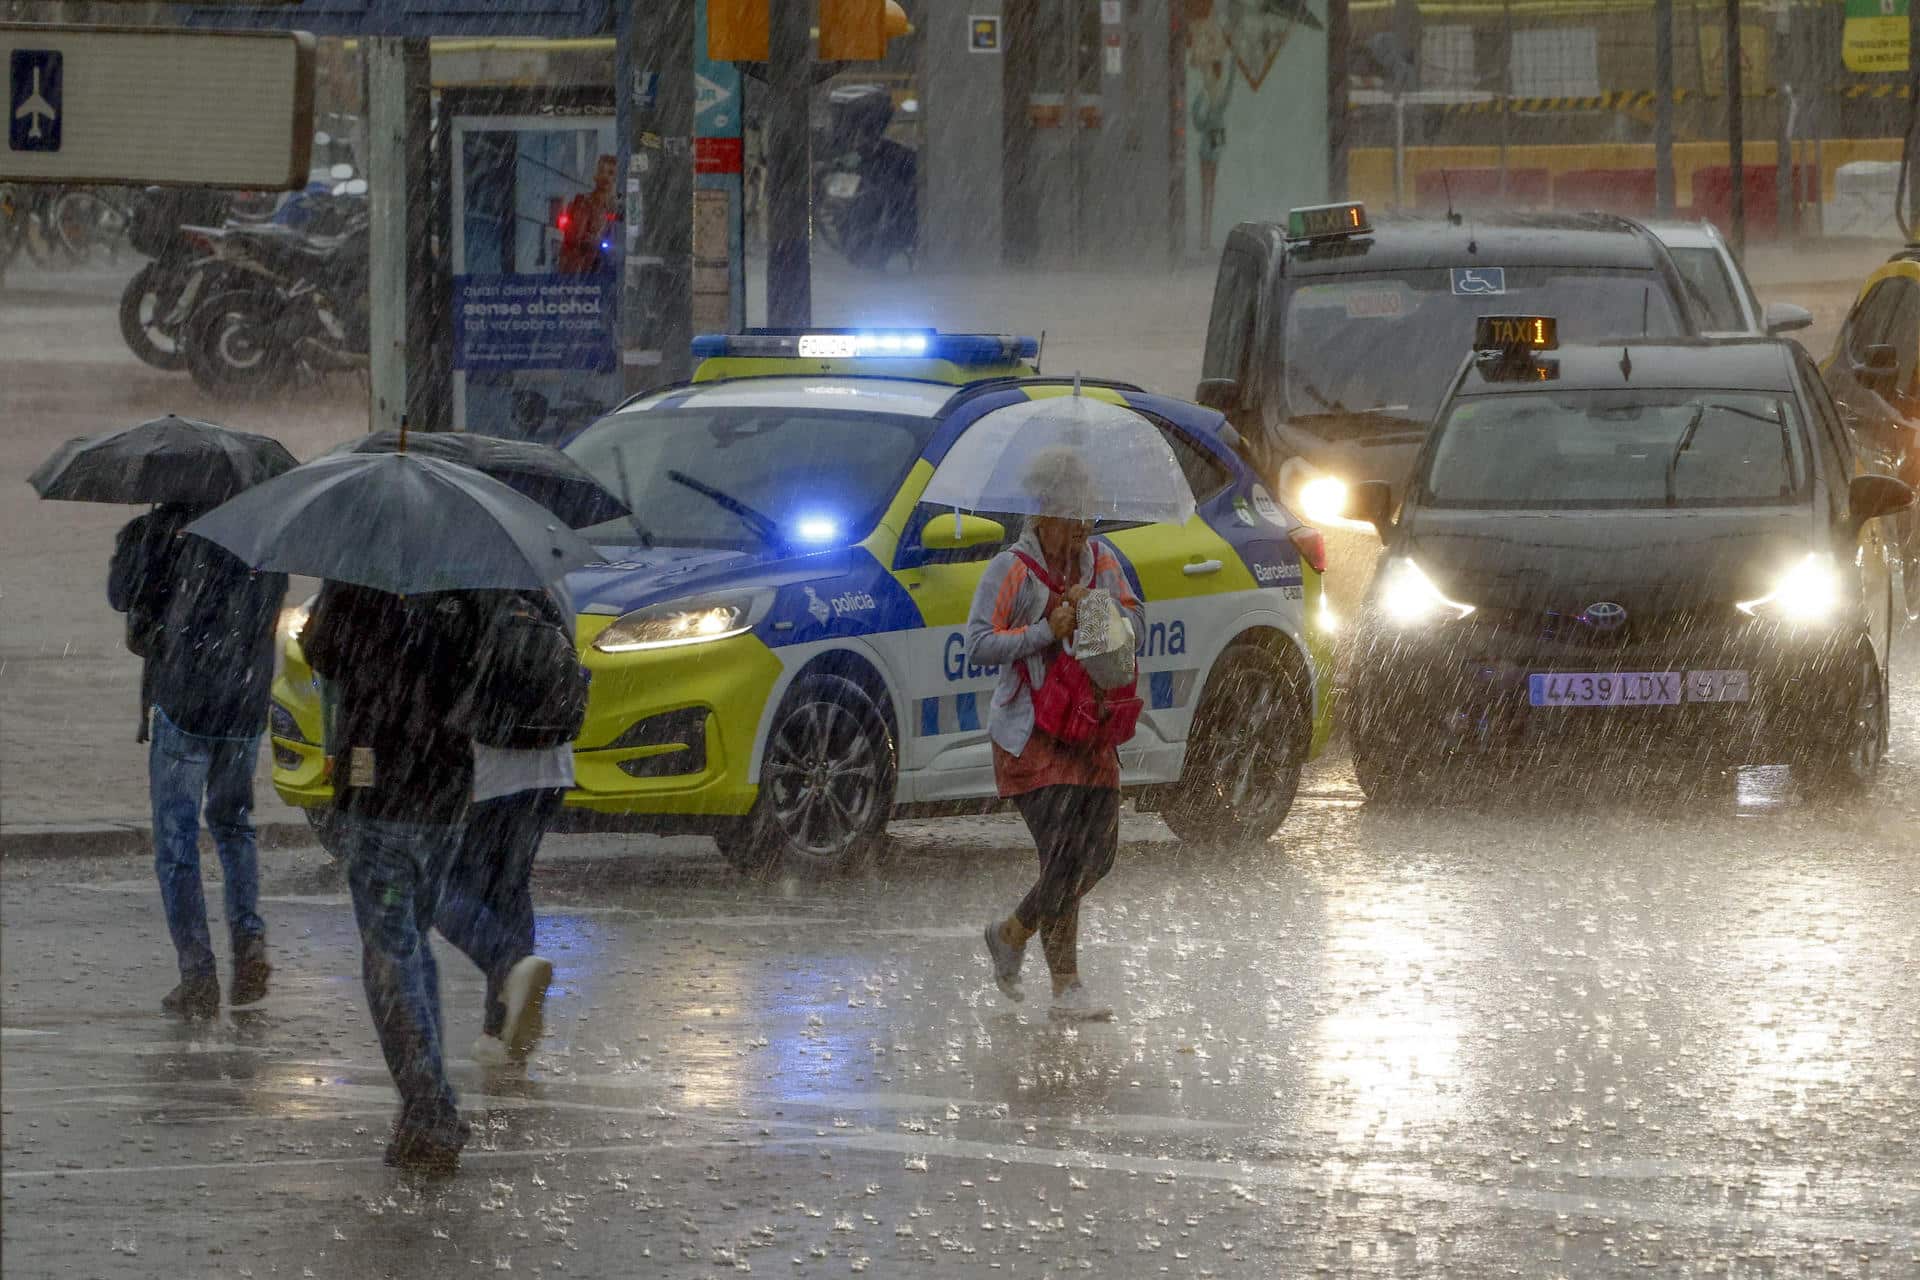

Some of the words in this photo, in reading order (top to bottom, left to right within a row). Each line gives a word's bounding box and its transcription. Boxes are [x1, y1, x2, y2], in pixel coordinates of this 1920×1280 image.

[1350, 207, 1359, 226] 1
[464, 303, 522, 315] sense
[527, 299, 601, 315] alcohol
[1492, 320, 1531, 343] TAXI
[1534, 319, 1545, 343] 1
[1253, 561, 1302, 581] Barcelona
[1546, 677, 1612, 702] 4439
[1621, 676, 1671, 702] LDX
